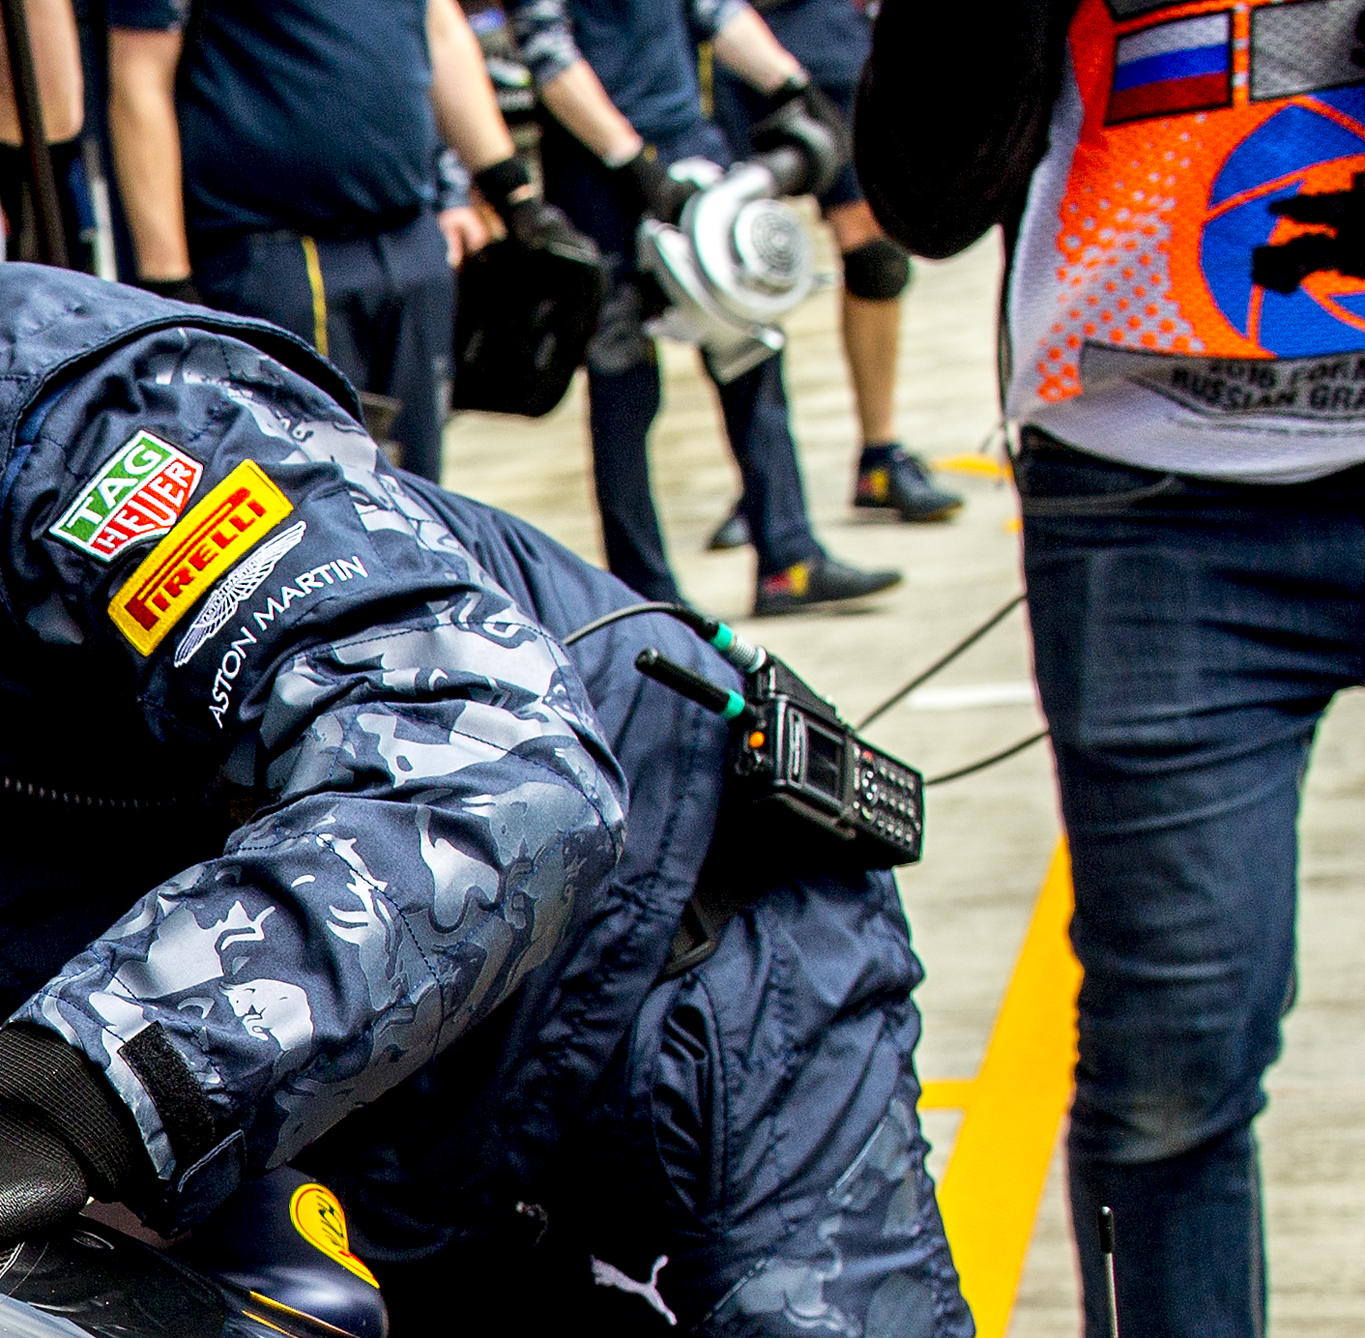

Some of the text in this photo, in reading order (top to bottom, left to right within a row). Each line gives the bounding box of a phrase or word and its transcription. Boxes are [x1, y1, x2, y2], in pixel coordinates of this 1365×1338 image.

[66, 443, 165, 530] TAG
[95, 460, 194, 550] HEUER
[124, 486, 267, 632] PIRELLI
[208, 555, 369, 729] ASTON MARTIN
